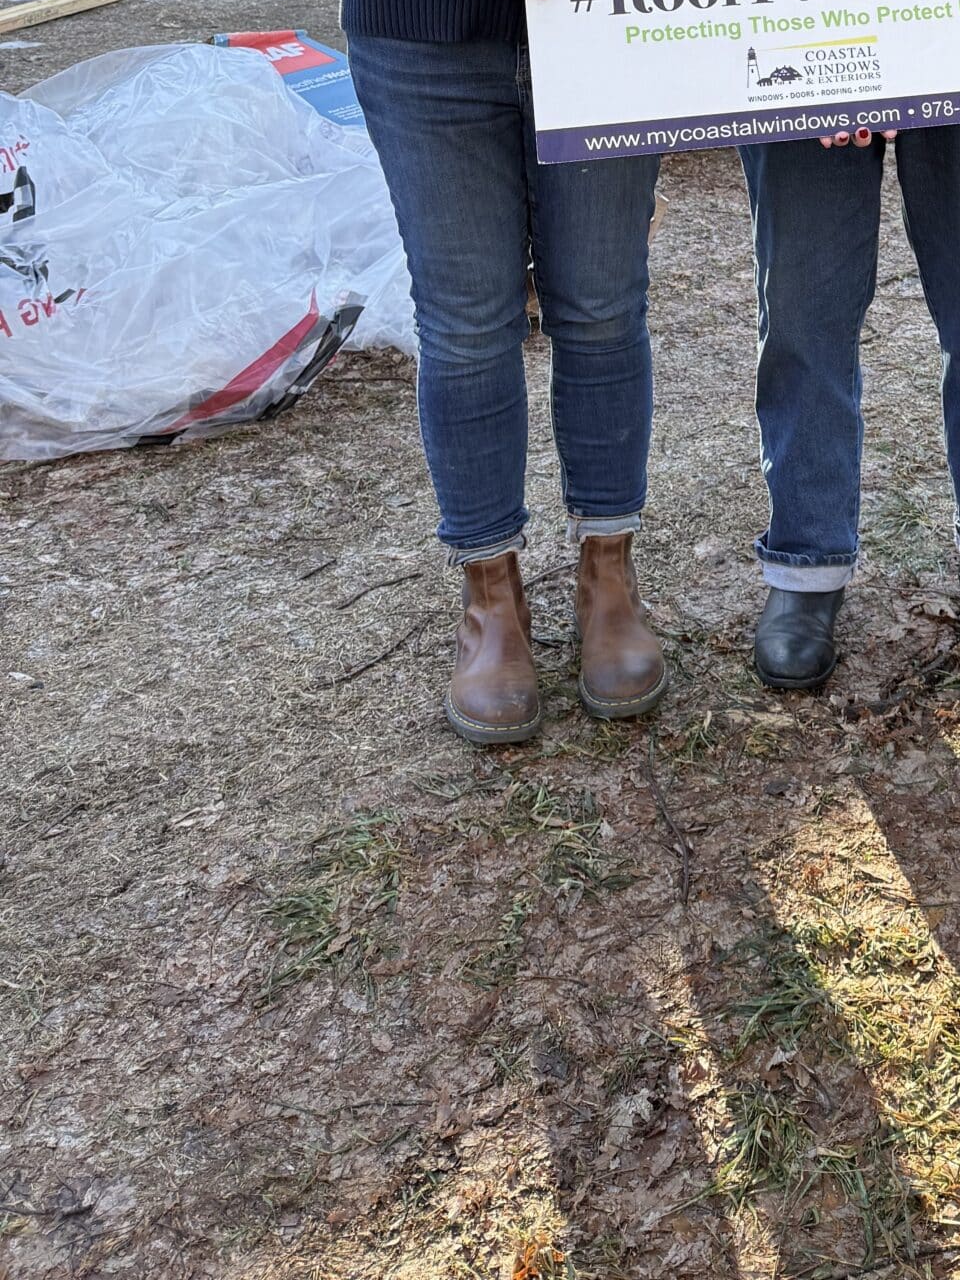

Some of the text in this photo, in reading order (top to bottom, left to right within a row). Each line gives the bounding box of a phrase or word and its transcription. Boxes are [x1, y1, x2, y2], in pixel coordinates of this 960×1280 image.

[625, 19, 742, 44] Protecting
[747, 12, 816, 34] Those
[821, 9, 871, 28] Who
[877, 2, 953, 23] Protect
[265, 42, 305, 62] AF
[805, 46, 877, 62] COASTAL
[803, 59, 880, 76] WINDOWS
[818, 71, 881, 85] EXTERIORS
[747, 84, 883, 102] WINDOWS DOORS ROOFING SIDING
[585, 105, 900, 151] www.mycoastalwindows.com
